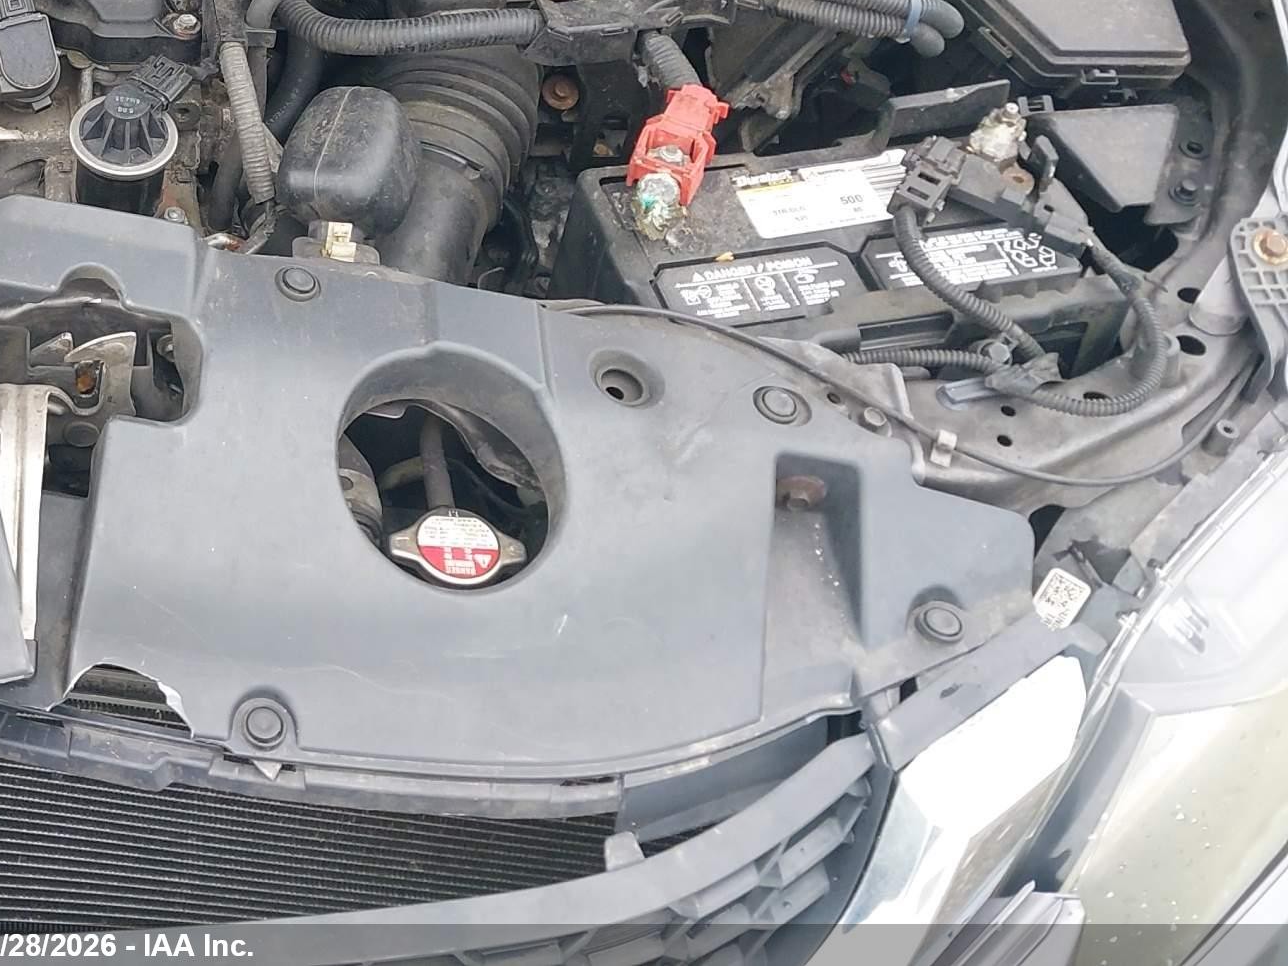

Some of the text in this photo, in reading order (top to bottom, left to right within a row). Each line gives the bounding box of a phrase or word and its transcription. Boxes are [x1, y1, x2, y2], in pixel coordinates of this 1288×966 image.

[840, 194, 864, 205] 500
[703, 265, 755, 281] DANGER
[765, 257, 812, 272] POISON
